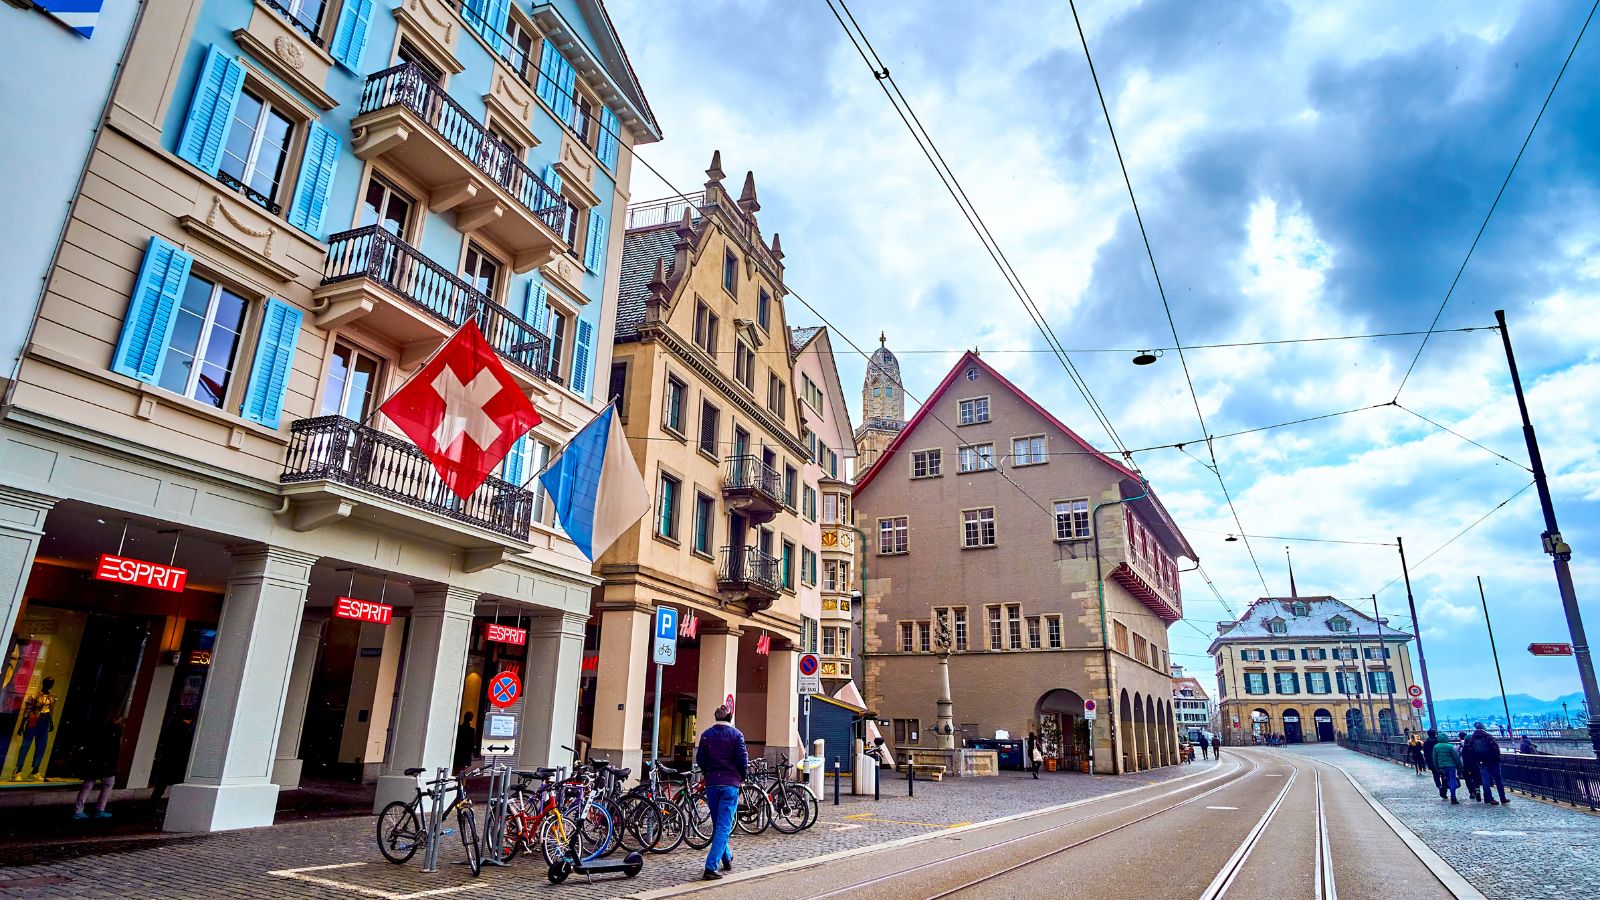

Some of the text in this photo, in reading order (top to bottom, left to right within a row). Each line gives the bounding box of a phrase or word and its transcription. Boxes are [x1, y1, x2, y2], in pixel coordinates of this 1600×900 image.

[100, 557, 185, 589] ESPRIT
[338, 599, 392, 622] ESPRIT
[490, 625, 526, 643] ESPRIT
[661, 613, 672, 635] P
